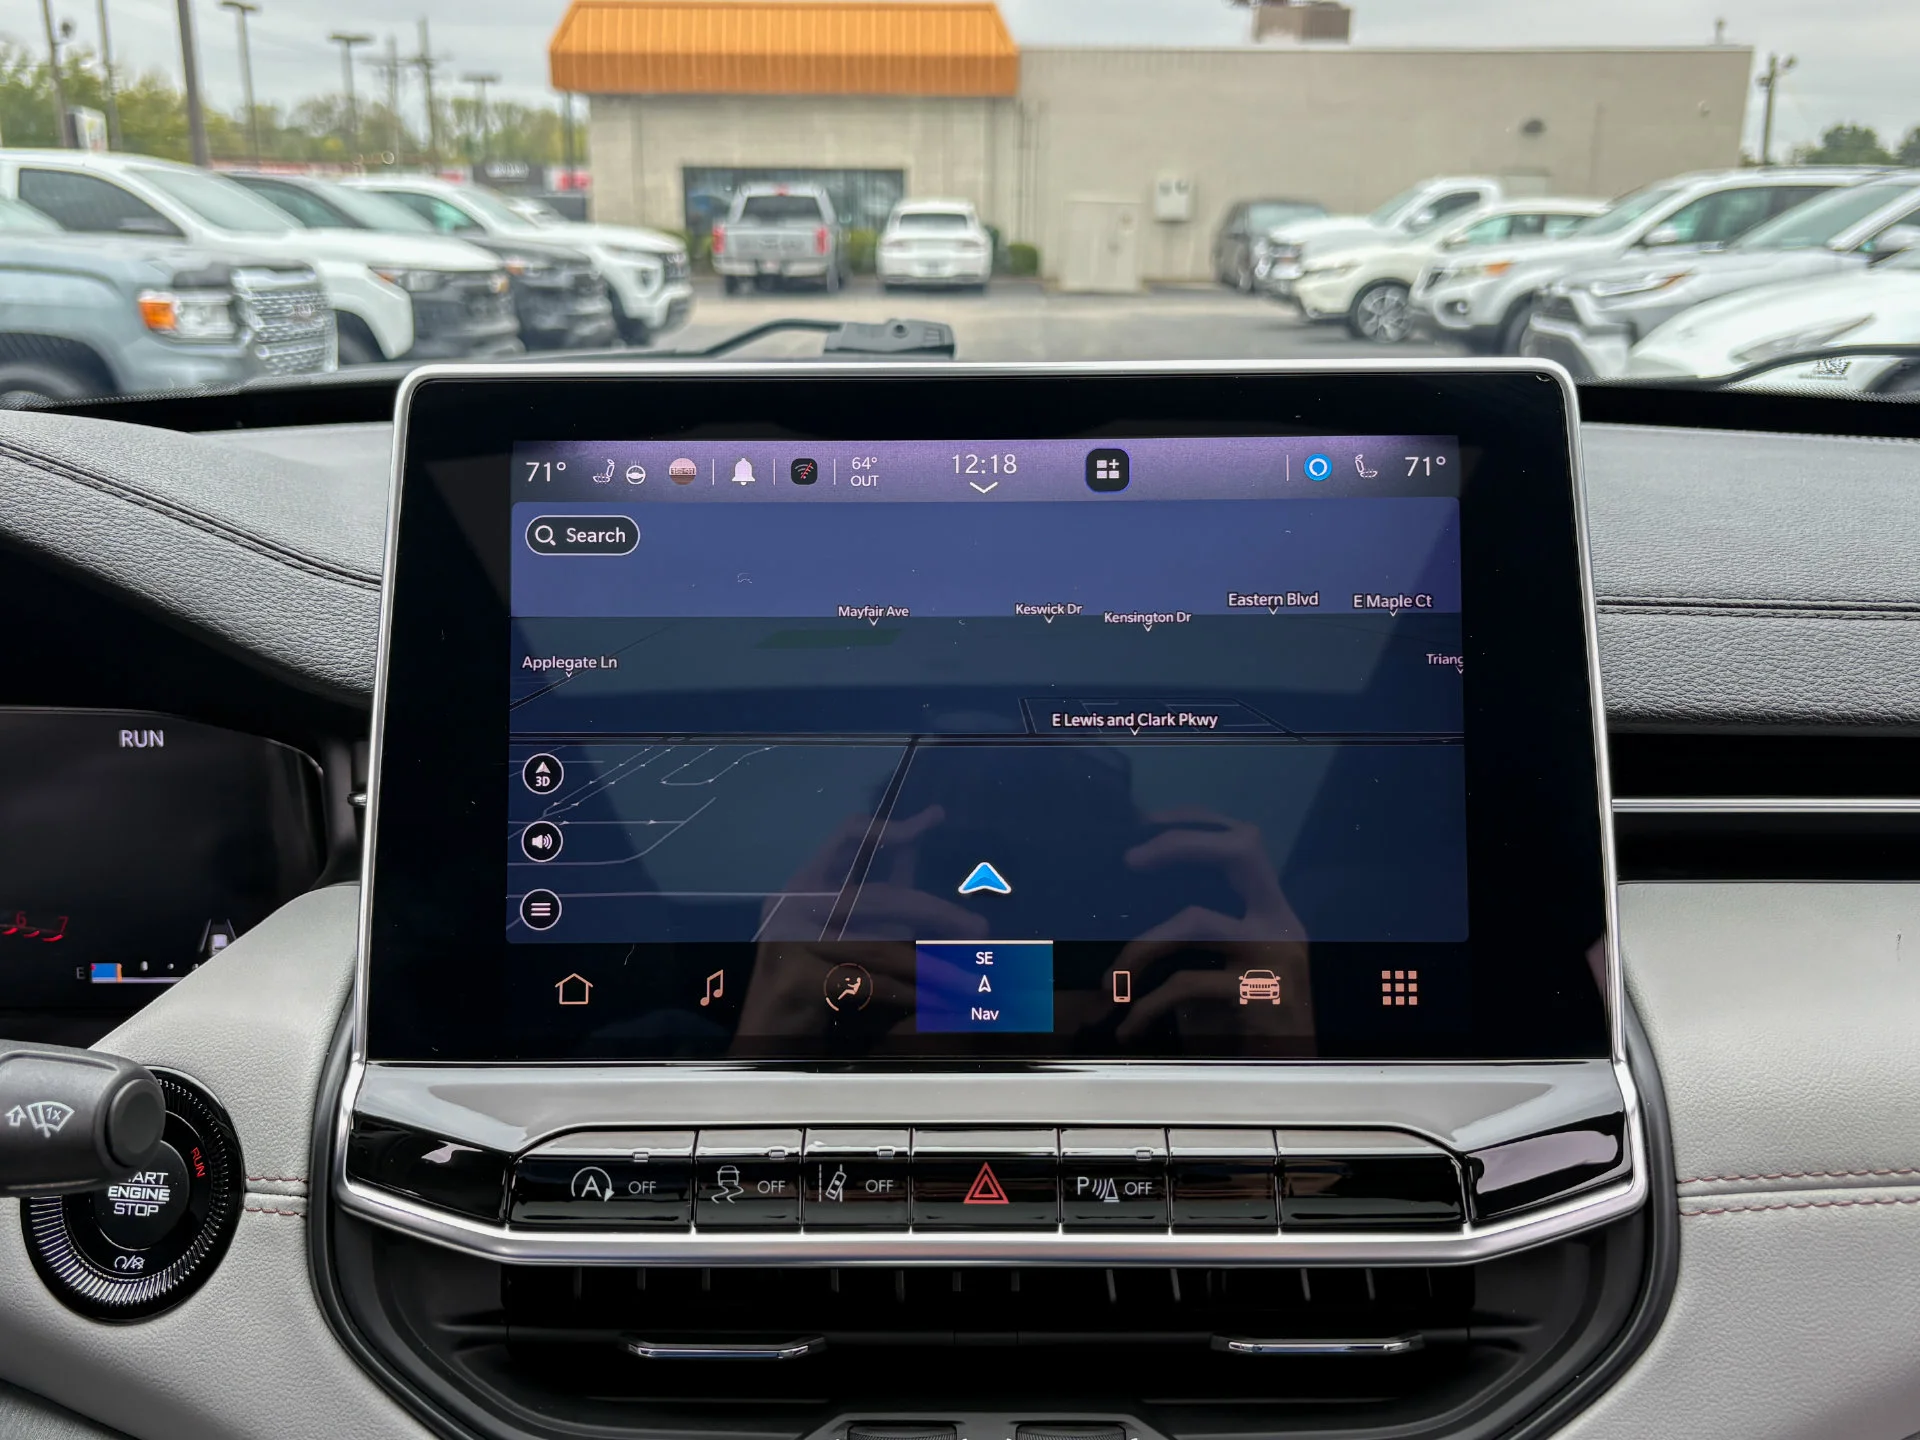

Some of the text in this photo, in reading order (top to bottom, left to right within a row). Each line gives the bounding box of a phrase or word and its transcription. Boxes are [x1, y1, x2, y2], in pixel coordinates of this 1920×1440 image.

[952, 453, 1017, 474] 12:18
[850, 475, 879, 487] OUT
[566, 527, 626, 544] Search
[1228, 591, 1319, 607] Eastern Blvd
[1354, 594, 1432, 612] E Maple Ct
[838, 605, 909, 620] Mayfair Ave
[1015, 603, 1082, 616] Keswick Dr
[1104, 611, 1191, 627] Kensington Dr
[522, 655, 617, 673] Applegate Ln
[1052, 712, 1218, 731] E Lewis and Clark Pkwy
[120, 730, 164, 748] RUN
[535, 776, 551, 787] 3D
[975, 951, 993, 965] SE
[971, 1007, 999, 1020] Nav
[190, 1146, 206, 1178] RUN
[107, 1185, 171, 1202] ENGINE
[628, 1181, 656, 1194] OFF
[757, 1180, 786, 1194] OFF
[865, 1179, 894, 1193] OFF
[1124, 1181, 1152, 1195] OFF
[113, 1202, 159, 1217] STOP
